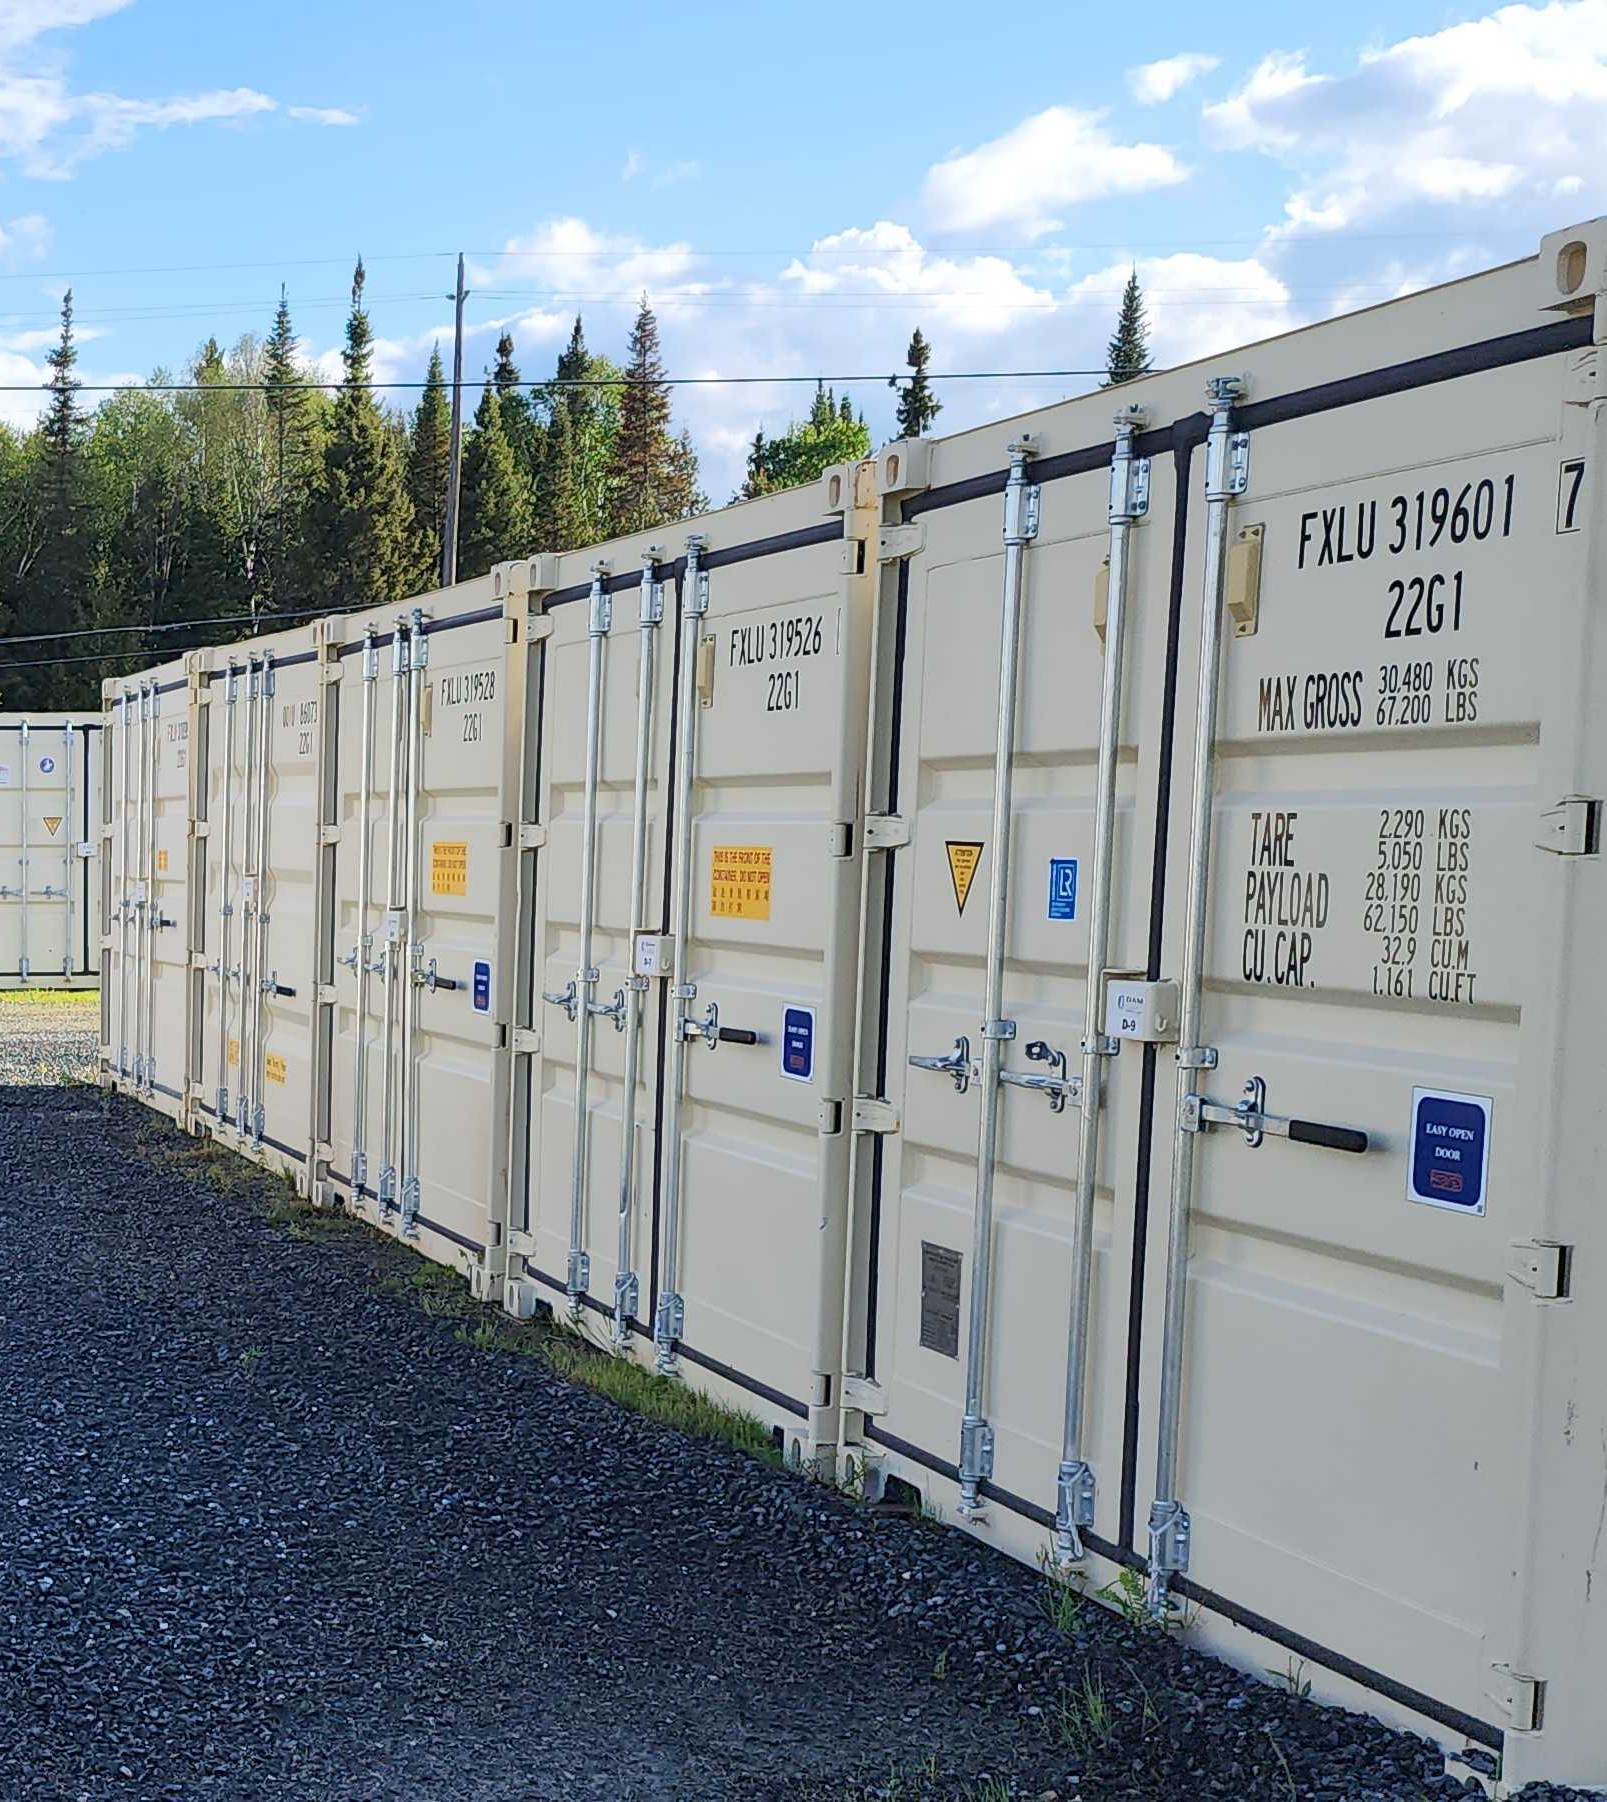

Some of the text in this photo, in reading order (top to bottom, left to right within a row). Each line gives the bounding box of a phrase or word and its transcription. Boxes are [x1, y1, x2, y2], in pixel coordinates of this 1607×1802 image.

[1298, 462, 1586, 569] FXLU 319601 7
[1385, 570, 1463, 638] 22G1
[730, 615, 823, 667] FXLU 319526
[441, 670, 496, 707] FXLU 319528
[767, 670, 799, 712] 22G1
[1378, 657, 1480, 694] 30,480 KGS
[1258, 670, 1363, 732] MAX GROSS
[1376, 691, 1478, 725] 67,200 LBS
[463, 713, 482, 742] 22G1
[1250, 812, 1298, 868] TARE
[1378, 809, 1471, 839] 2,290 KGS
[1377, 841, 1469, 873] 5,050 LBS
[1244, 871, 1329, 929] PAYLOAD
[1365, 871, 1467, 905] 28,190 KGS
[1363, 904, 1465, 937] 62,150 LBS
[1381, 936, 1470, 971] 32.9 CU.M
[1428, 973, 1477, 1005] CU.FT
[1122, 1018, 1136, 1031] D-9
[1426, 1123, 1474, 1140] EASY OPEN
[1435, 1147, 1460, 1160] DOOR
